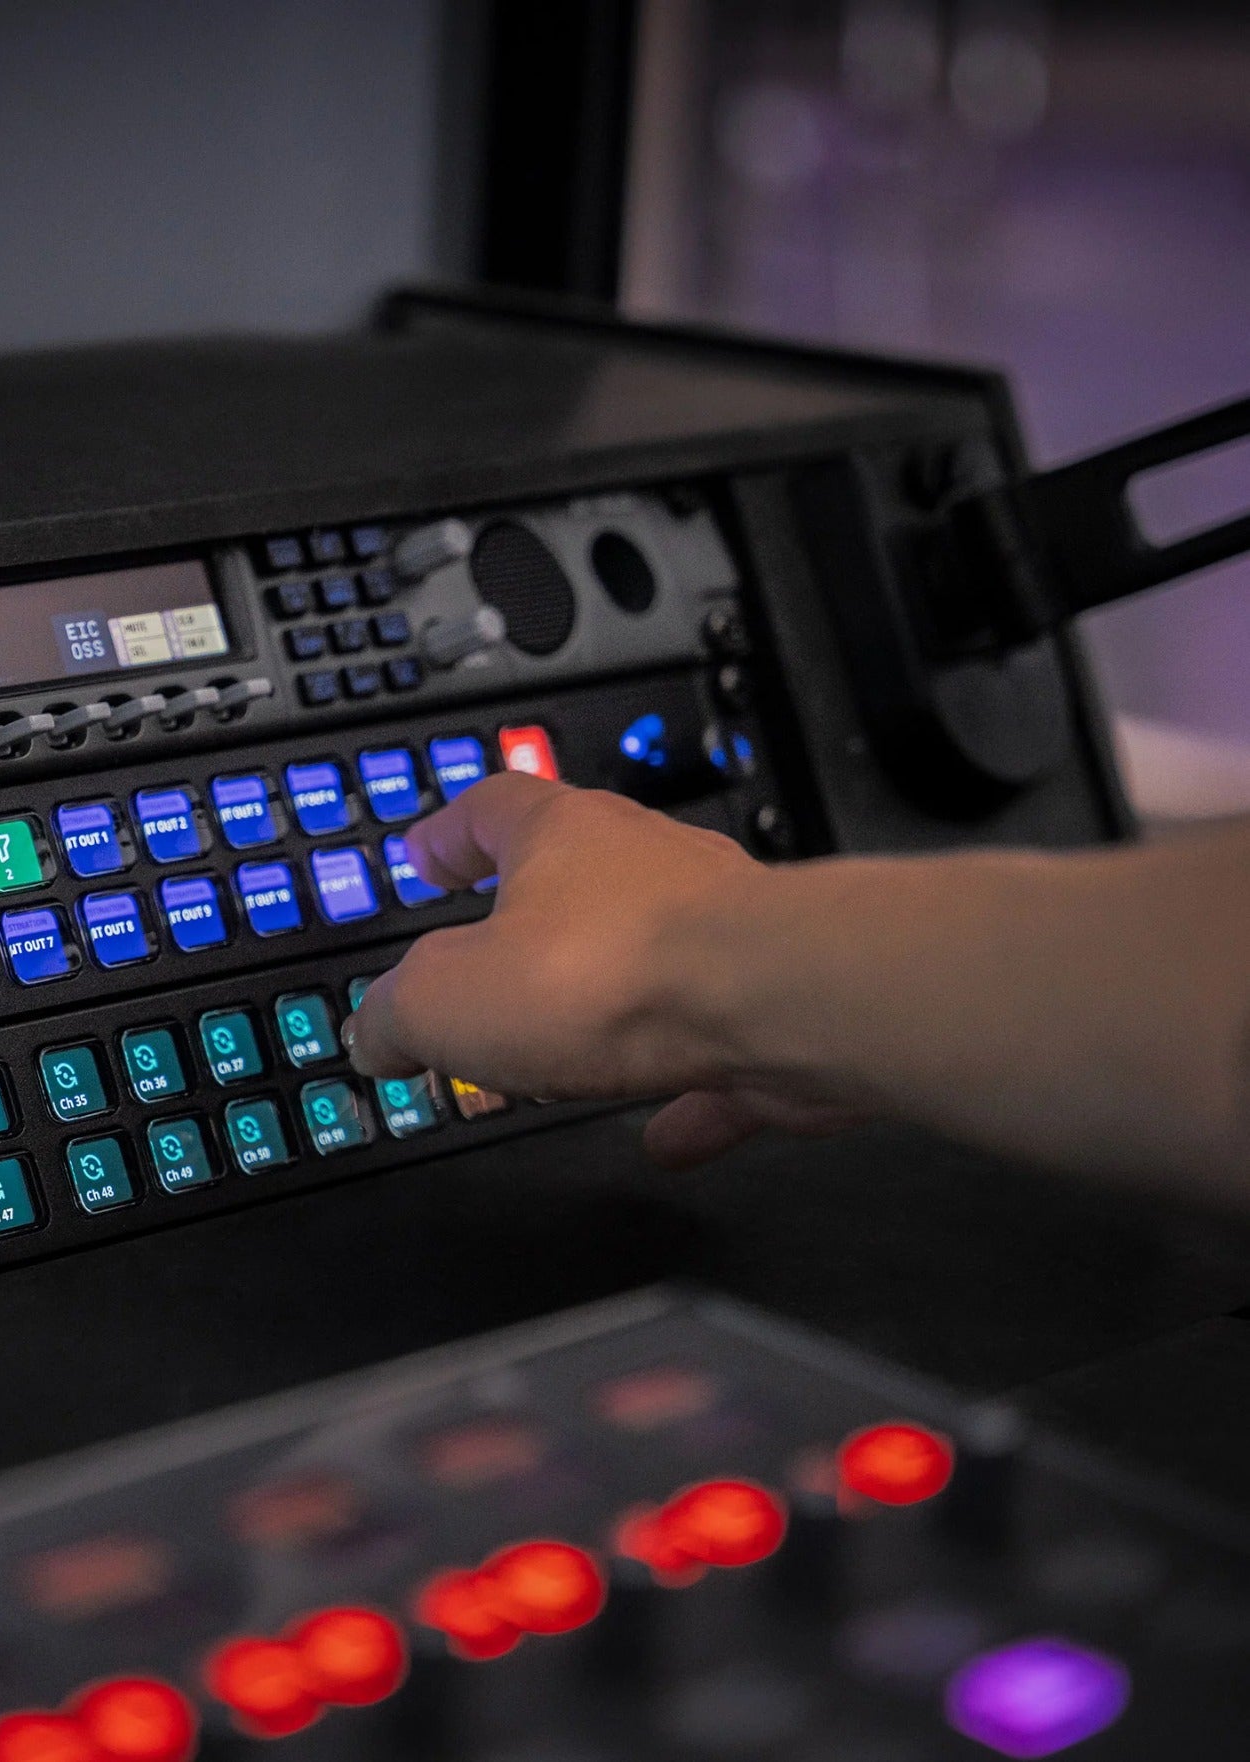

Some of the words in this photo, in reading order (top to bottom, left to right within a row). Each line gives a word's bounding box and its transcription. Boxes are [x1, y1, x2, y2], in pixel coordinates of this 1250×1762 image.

[65, 620, 100, 641] EIC
[70, 640, 106, 660] OSS
[156, 818, 178, 833] OUT
[177, 816, 188, 830] 2
[78, 832, 101, 848] OUT
[100, 831, 109, 843] 1
[5, 869, 15, 881] 2
[182, 905, 204, 921] OUT
[202, 904, 212, 917] 9
[104, 921, 125, 937] OUT
[126, 920, 135, 932] 8
[24, 938, 45, 952] OUT
[46, 936, 54, 948] 7
[217, 1061, 232, 1075] Ch
[230, 1057, 244, 1071] 37
[139, 1079, 154, 1093] Ch
[152, 1076, 167, 1089] 36
[59, 1096, 75, 1110] Ch
[73, 1094, 88, 1107] 35
[243, 1150, 258, 1164] Ch
[256, 1147, 271, 1160] 50
[165, 1169, 181, 1183] Ch
[179, 1166, 193, 1179] 49
[86, 1188, 101, 1202] Ch
[99, 1185, 114, 1198] 48
[0, 1208, 14, 1222] 47
